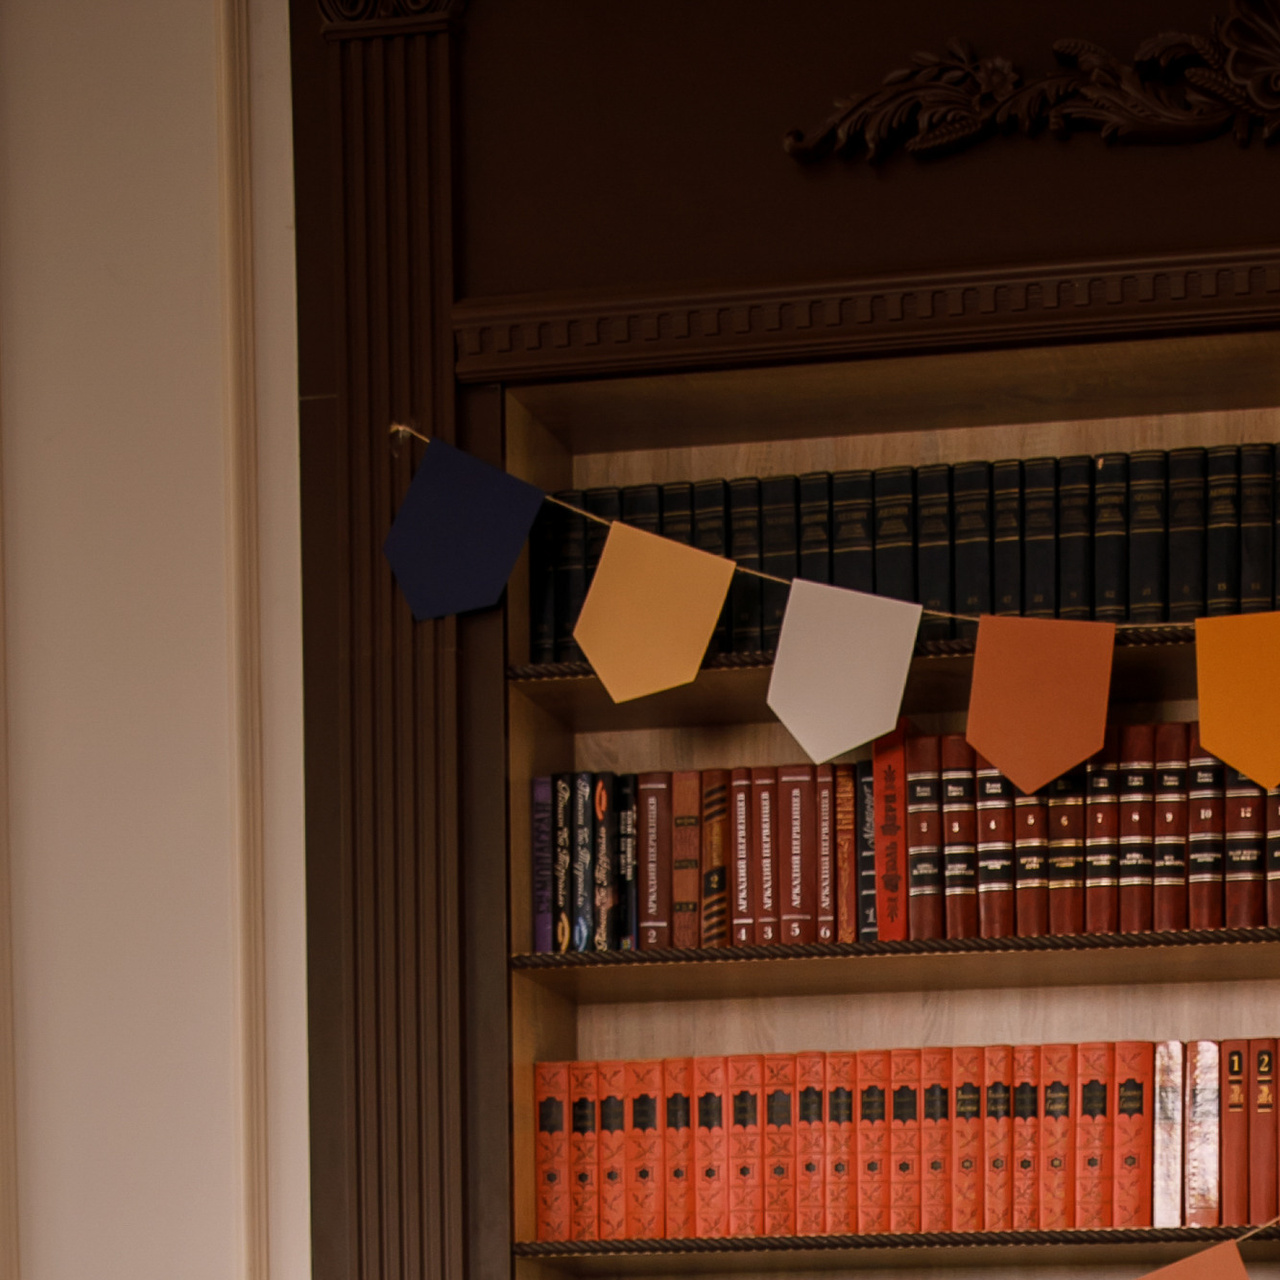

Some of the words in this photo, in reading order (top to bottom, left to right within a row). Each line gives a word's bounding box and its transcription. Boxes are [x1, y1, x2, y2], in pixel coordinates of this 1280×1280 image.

[648, 930, 657, 943] 2
[737, 928, 747, 941] 4
[763, 926, 773, 940] 3
[790, 923, 801, 937] 5
[820, 927, 831, 939] 6
[1231, 1054, 1241, 1072] 1
[1258, 1054, 1270, 1072] 2
